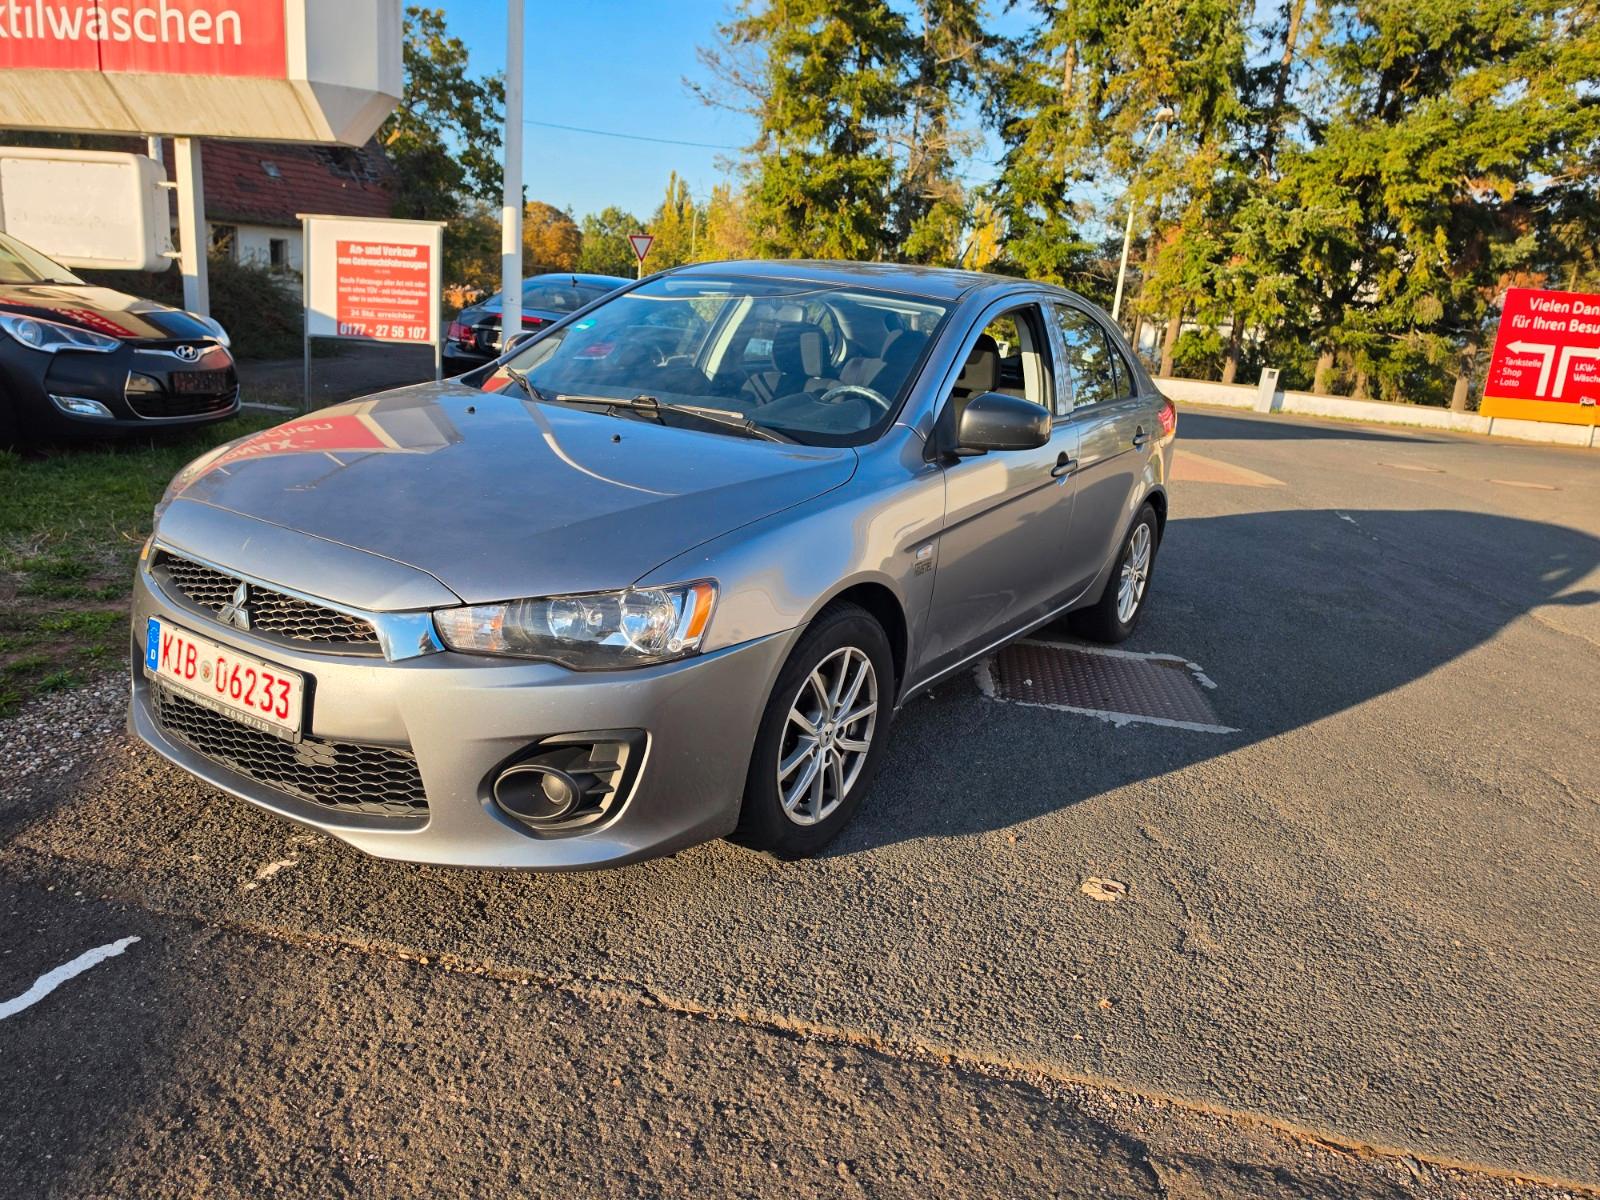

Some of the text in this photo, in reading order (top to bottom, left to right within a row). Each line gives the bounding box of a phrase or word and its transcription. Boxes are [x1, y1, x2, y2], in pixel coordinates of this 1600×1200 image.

[365, 245, 382, 256] und
[382, 246, 418, 258] Verkauf
[1529, 296, 1600, 316] Vielen Dan
[350, 309, 360, 317] 24
[377, 311, 416, 320] erreichbar
[1512, 314, 1531, 329] für
[1533, 315, 1567, 332] Ihren
[340, 322, 366, 336] 0177
[375, 324, 389, 337] 27
[391, 325, 405, 338] 56
[407, 326, 427, 340] 107
[1505, 357, 1542, 369] Tankstelle
[1501, 367, 1522, 378] Shop
[1500, 378, 1520, 388] Lotto
[151, 648, 156, 661] D
[162, 631, 198, 680] KIB
[215, 655, 291, 720] 06233
